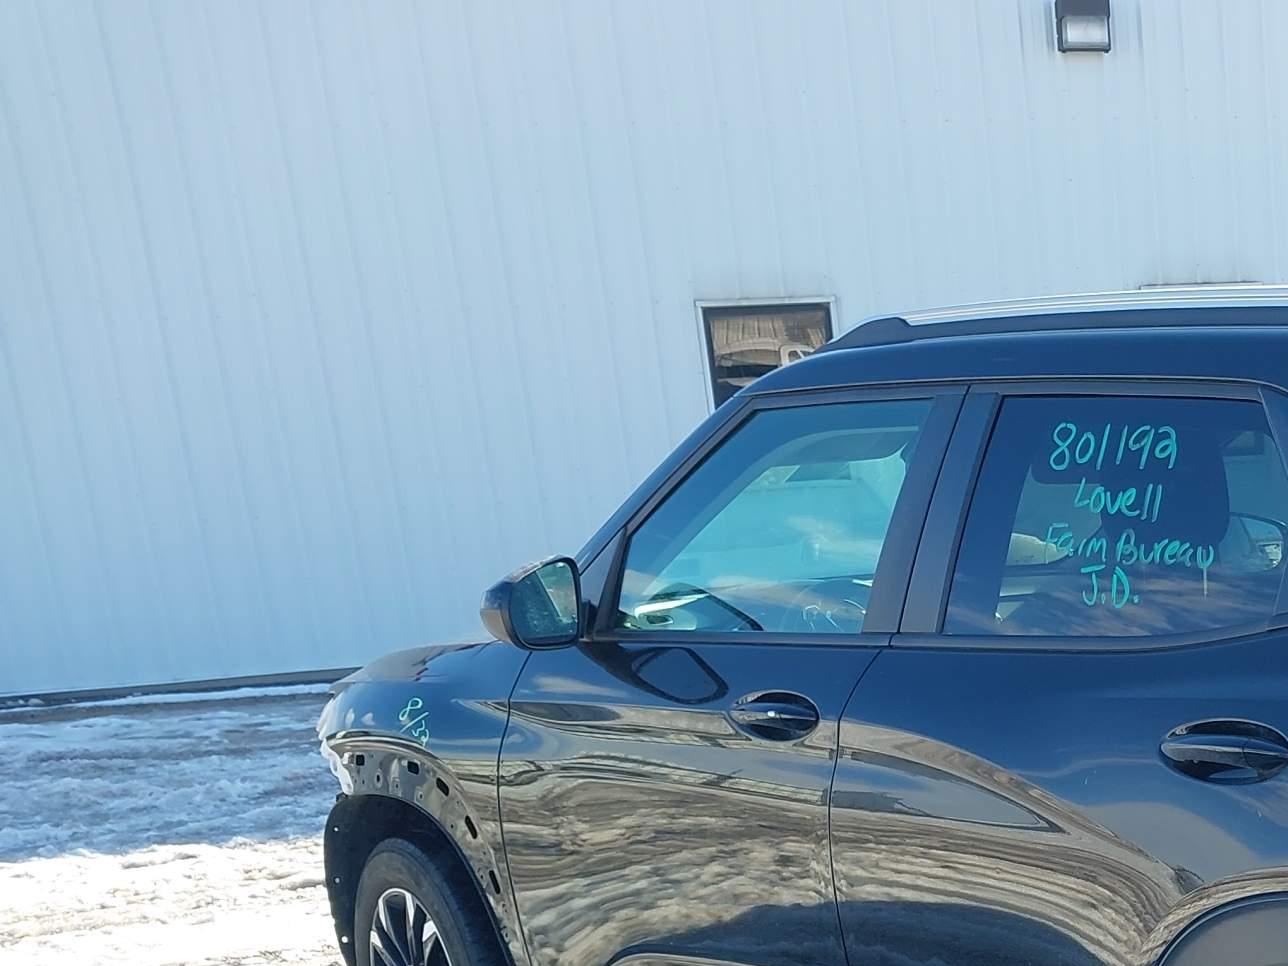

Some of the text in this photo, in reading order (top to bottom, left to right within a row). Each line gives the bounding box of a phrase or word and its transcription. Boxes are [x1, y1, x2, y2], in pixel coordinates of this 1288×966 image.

[1050, 422, 1178, 470] 801192
[1074, 477, 1163, 523] Lovell
[1081, 564, 1139, 609] J.D.
